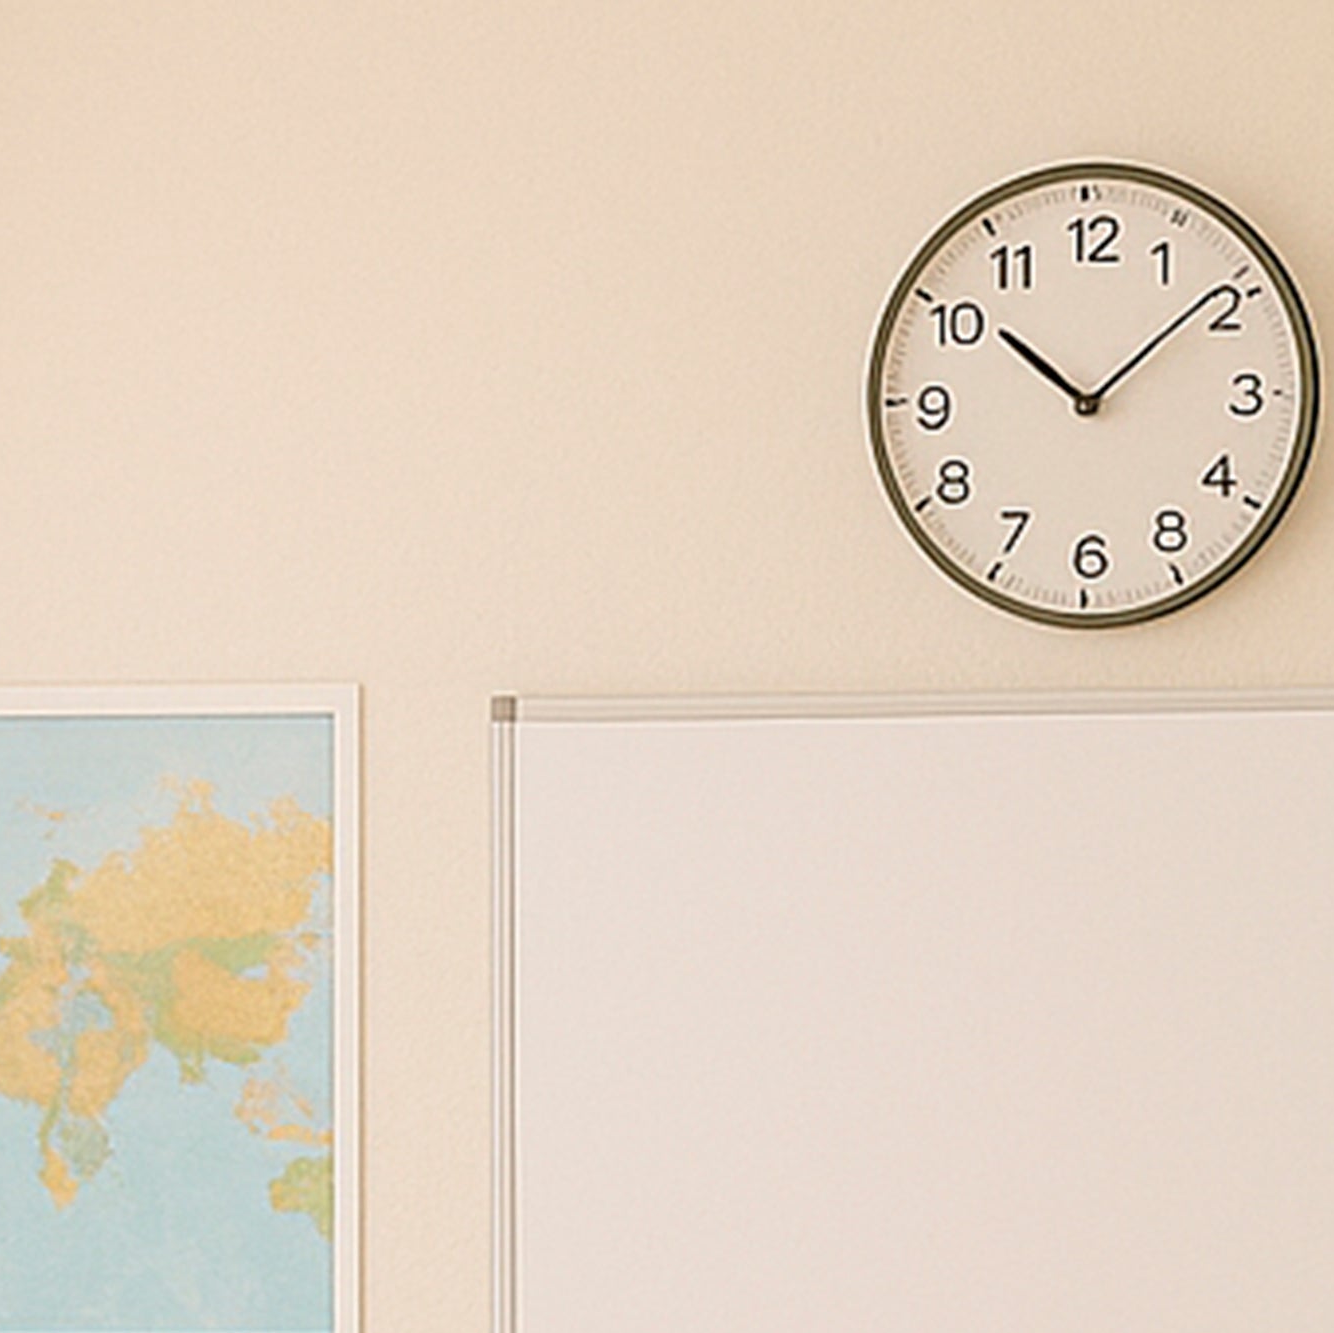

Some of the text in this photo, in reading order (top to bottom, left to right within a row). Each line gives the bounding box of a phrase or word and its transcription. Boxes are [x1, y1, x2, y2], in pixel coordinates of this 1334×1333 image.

[1067, 215, 1120, 263] 12
[990, 245, 1032, 290] 11
[1151, 241, 1169, 286] 1
[930, 301, 985, 346] 10
[1208, 284, 1242, 332] 2
[917, 385, 951, 431] 9
[1229, 373, 1264, 417] 3
[936, 459, 970, 505] 8
[1201, 454, 1238, 498] 4
[1001, 511, 1030, 554] 7
[1153, 510, 1188, 553] 8
[1073, 534, 1109, 580] 6
